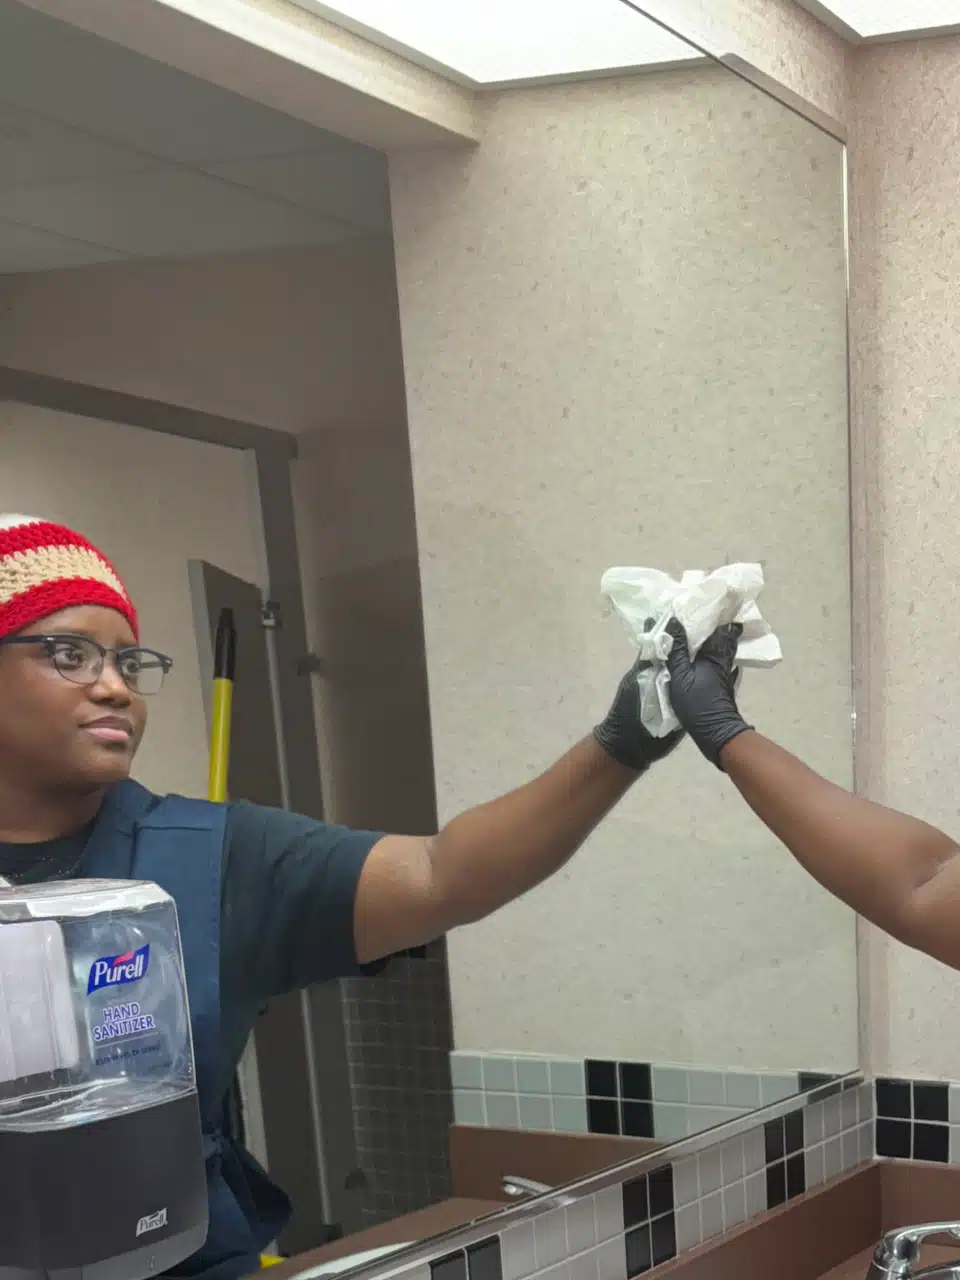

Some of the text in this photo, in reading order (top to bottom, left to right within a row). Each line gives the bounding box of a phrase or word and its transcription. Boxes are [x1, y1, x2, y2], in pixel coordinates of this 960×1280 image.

[94, 954, 144, 986] Purell
[103, 1002, 140, 1023] HAND
[93, 1014, 156, 1041] SANITIZER
